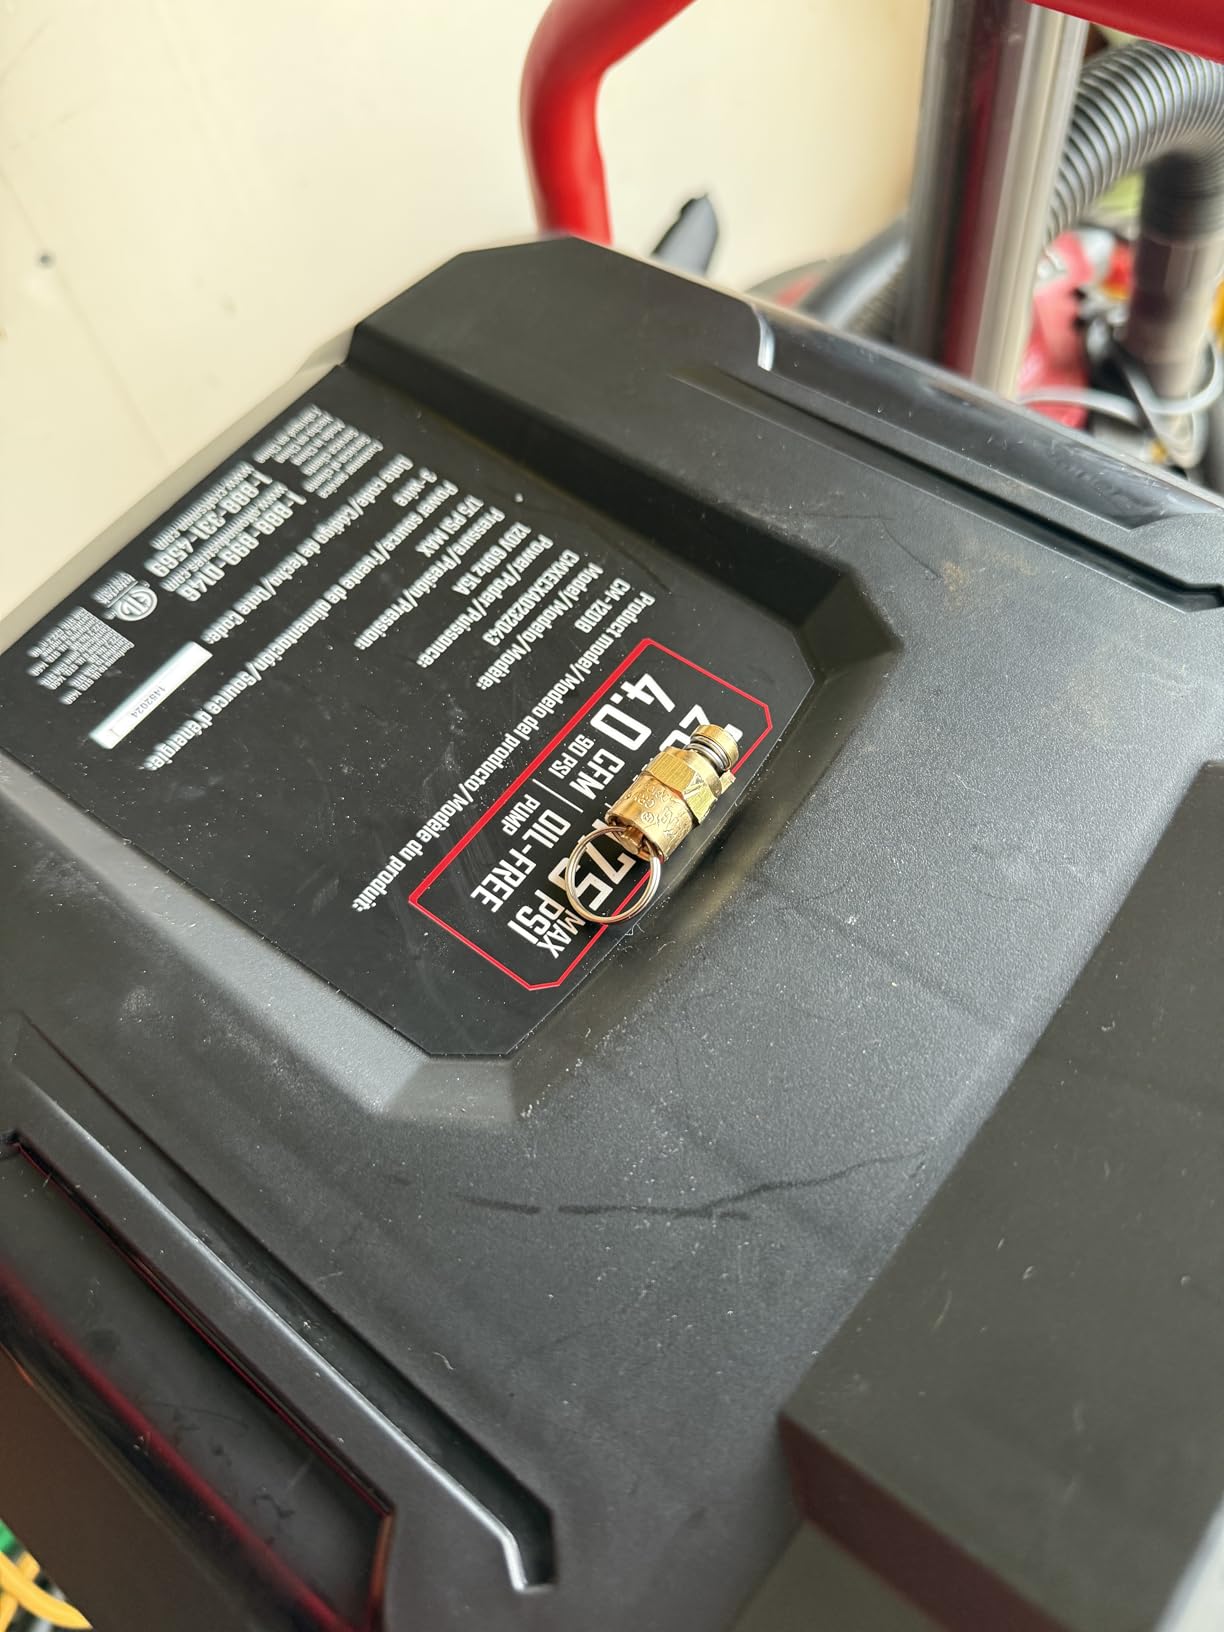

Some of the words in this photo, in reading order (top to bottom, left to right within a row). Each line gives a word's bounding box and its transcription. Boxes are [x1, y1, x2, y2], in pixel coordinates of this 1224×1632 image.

[416, 480, 459, 518] Power
[456, 494, 484, 518] 175
[415, 527, 450, 558] MAX
[439, 510, 467, 535] PSI
[498, 522, 532, 552] 120V
[323, 584, 348, 604] de
[451, 572, 482, 596] 15A
[477, 563, 603, 689] Model/Modelo/Modèle:
[605, 591, 656, 638] Product
[532, 633, 614, 718] model/Modelo
[512, 715, 540, 741] del
[590, 674, 675, 751] 4.0
[567, 733, 595, 757] 90
[548, 752, 578, 780] PSI
[569, 748, 625, 800] CFM
[416, 733, 520, 842] producto/Modèle
[501, 794, 541, 836] PUMP
[398, 839, 424, 861] du
[471, 810, 570, 912] OIL-FREE
[352, 855, 406, 912] produit:
[507, 889, 565, 944] PSI
[536, 910, 585, 959] MAX
